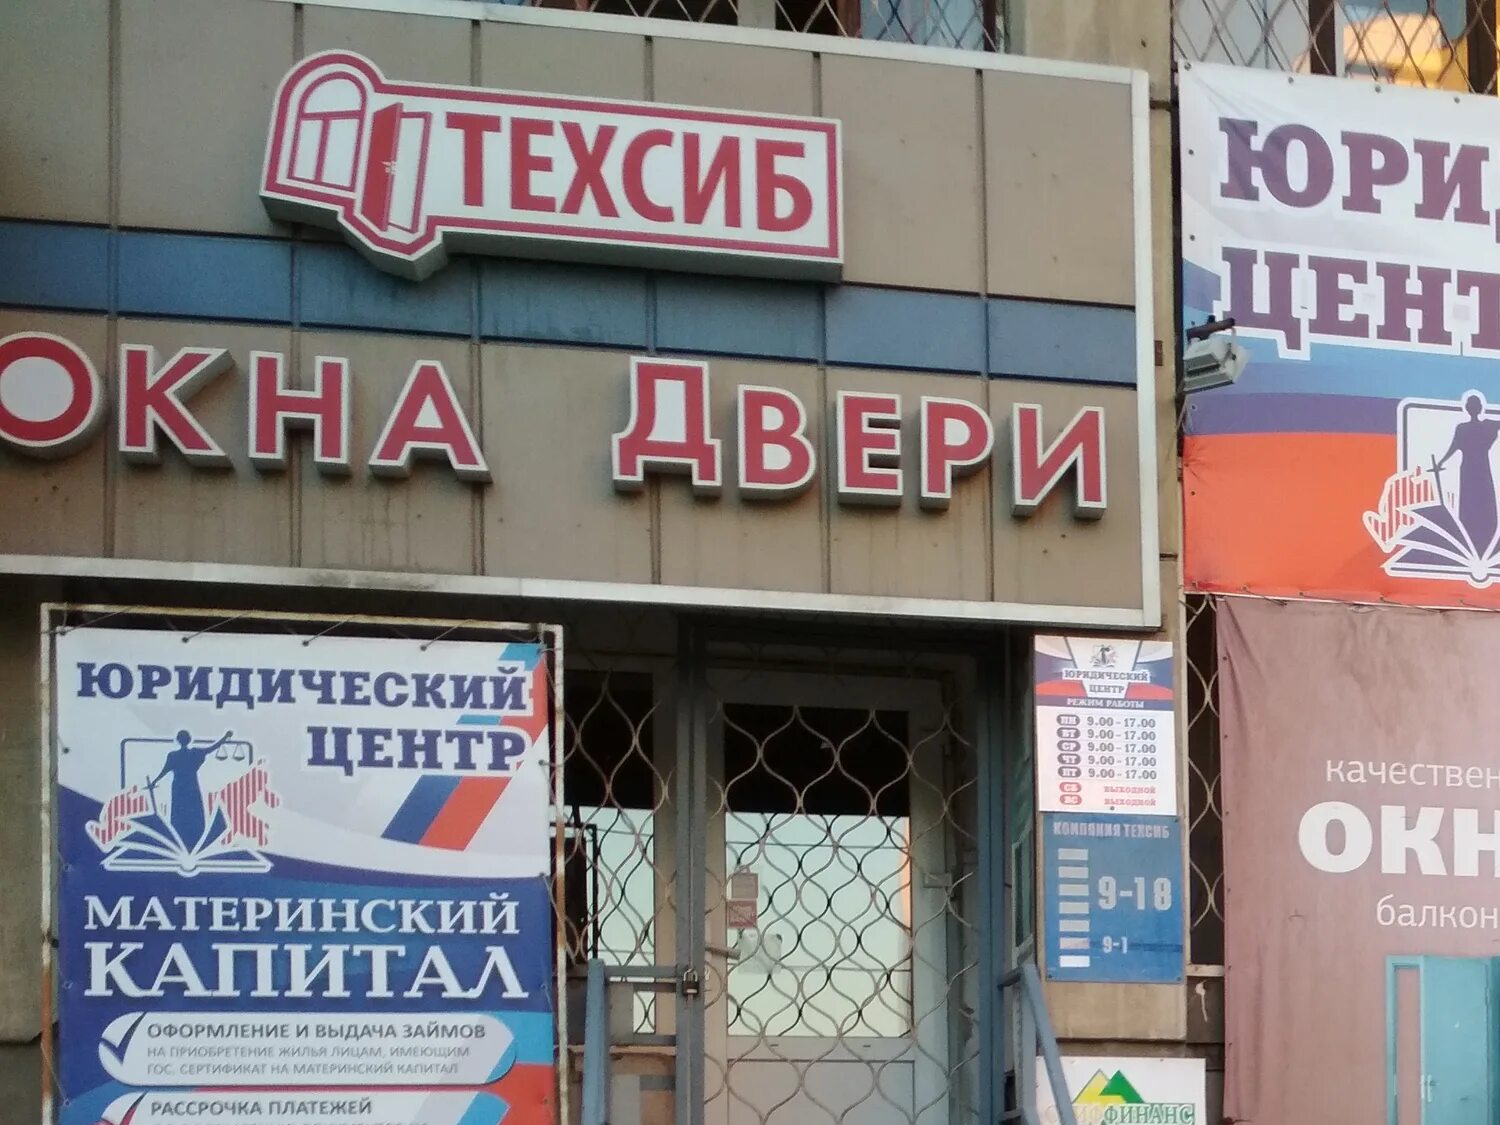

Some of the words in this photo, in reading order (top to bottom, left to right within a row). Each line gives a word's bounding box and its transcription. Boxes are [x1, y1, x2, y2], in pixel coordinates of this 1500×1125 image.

[446, 111, 814, 233] ТЕХСИБ
[0, 331, 492, 482] ОКНА
[611, 356, 1108, 516] ДВЕРИ
[1064, 670, 1148, 681] ЮРИДИЧЕСКИЙ
[76, 661, 527, 711] ЮРИДИЧЕСКИЙ
[1089, 684, 1125, 694] ЦЕНТР
[1067, 698, 1103, 707] РЕЖИМ
[1106, 700, 1144, 708] РАБОТЫ
[306, 725, 527, 774] ЦЕНТР
[1053, 822, 1121, 838] КОМПАНИЯ
[1123, 824, 1169, 838] ТЕХСИБ
[1098, 876, 1172, 911] 9-18
[84, 893, 520, 935] МАТЕРИНСКИЙ
[1102, 936, 1128, 954] 9-1
[84, 942, 529, 998] КАПИТАЛ
[147, 1023, 289, 1039] ОФОРМЛЕНИЕ
[295, 1024, 309, 1039] И
[316, 1024, 397, 1041] ВЫДАЧА
[402, 1021, 486, 1039] ЗАЙМОВ
[147, 1047, 165, 1058] НА
[170, 1047, 275, 1058] ПРИОБРЕТЕНИЕ
[179, 1063, 267, 1075] СЕРТИФИКАТ
[271, 1063, 289, 1075] НА
[293, 1061, 393, 1075] МАТЕРИНСКИЙ
[397, 1063, 458, 1075] КАПИТАЛ
[151, 1101, 263, 1116] РАССРОЧКА
[268, 1099, 372, 1115] ПЛАТЕЖЕЙ
